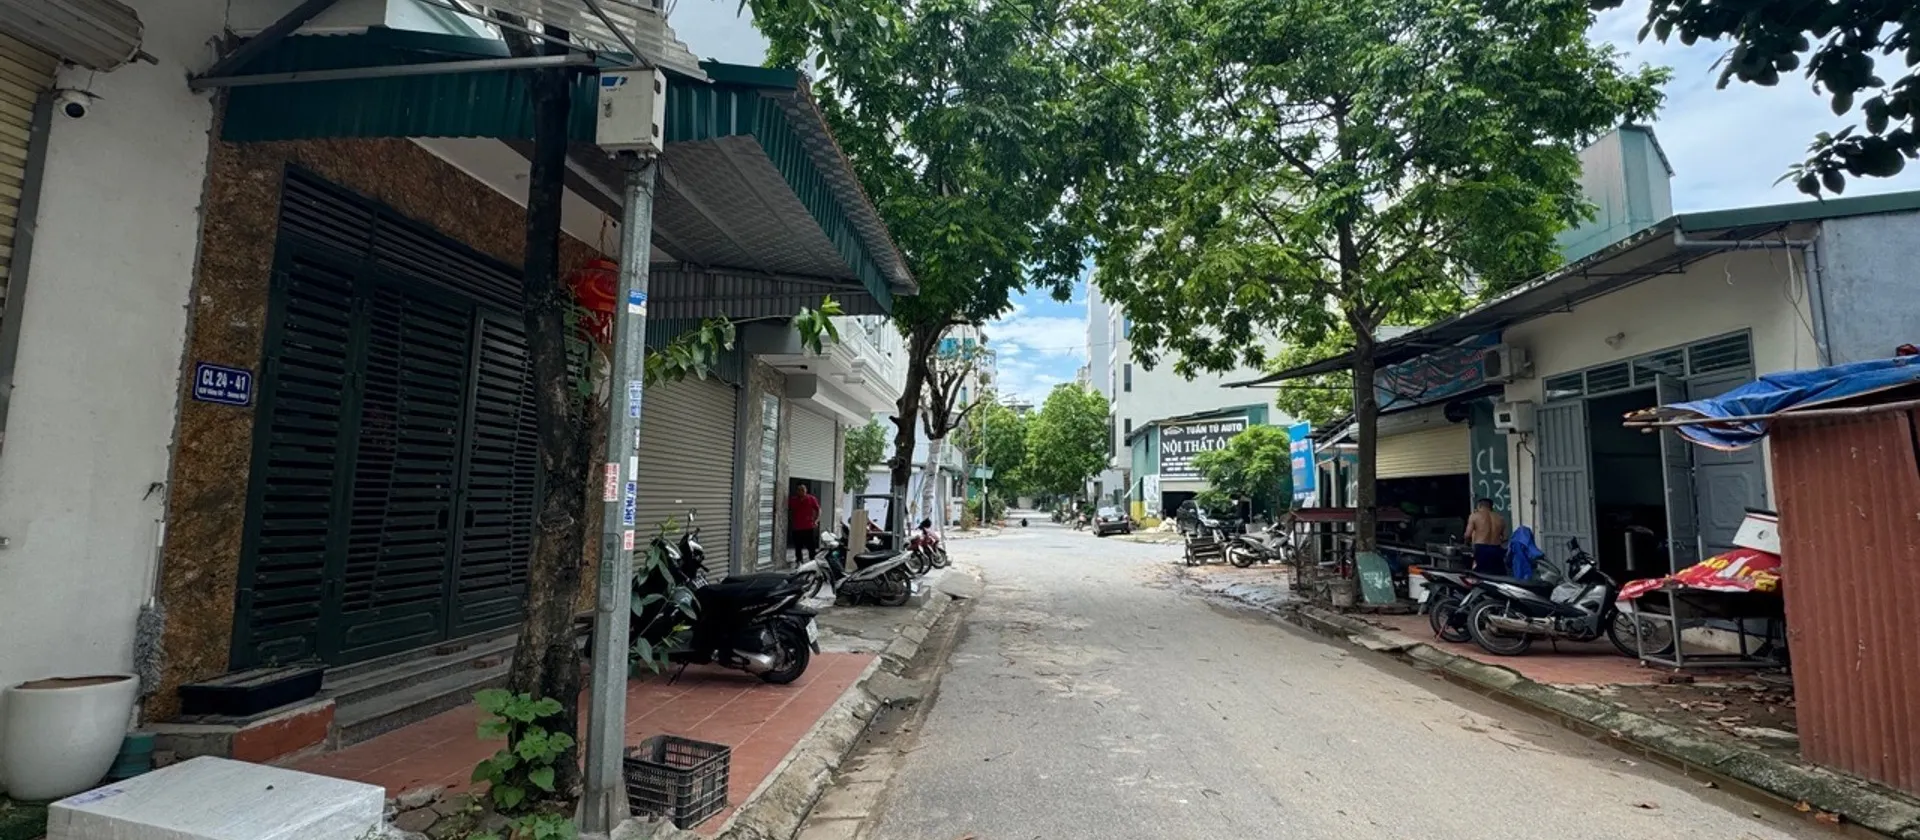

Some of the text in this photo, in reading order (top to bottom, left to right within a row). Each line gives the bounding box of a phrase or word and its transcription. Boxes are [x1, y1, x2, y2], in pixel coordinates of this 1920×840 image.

[202, 369, 214, 386] CL
[215, 371, 228, 388] 24
[235, 375, 246, 391] 41
[1221, 422, 1243, 432] AUTO
[1162, 438, 1182, 455] NỘI
[1184, 435, 1215, 453] THẤT
[1216, 436, 1226, 451] Ô
[1476, 446, 1503, 475] CL
